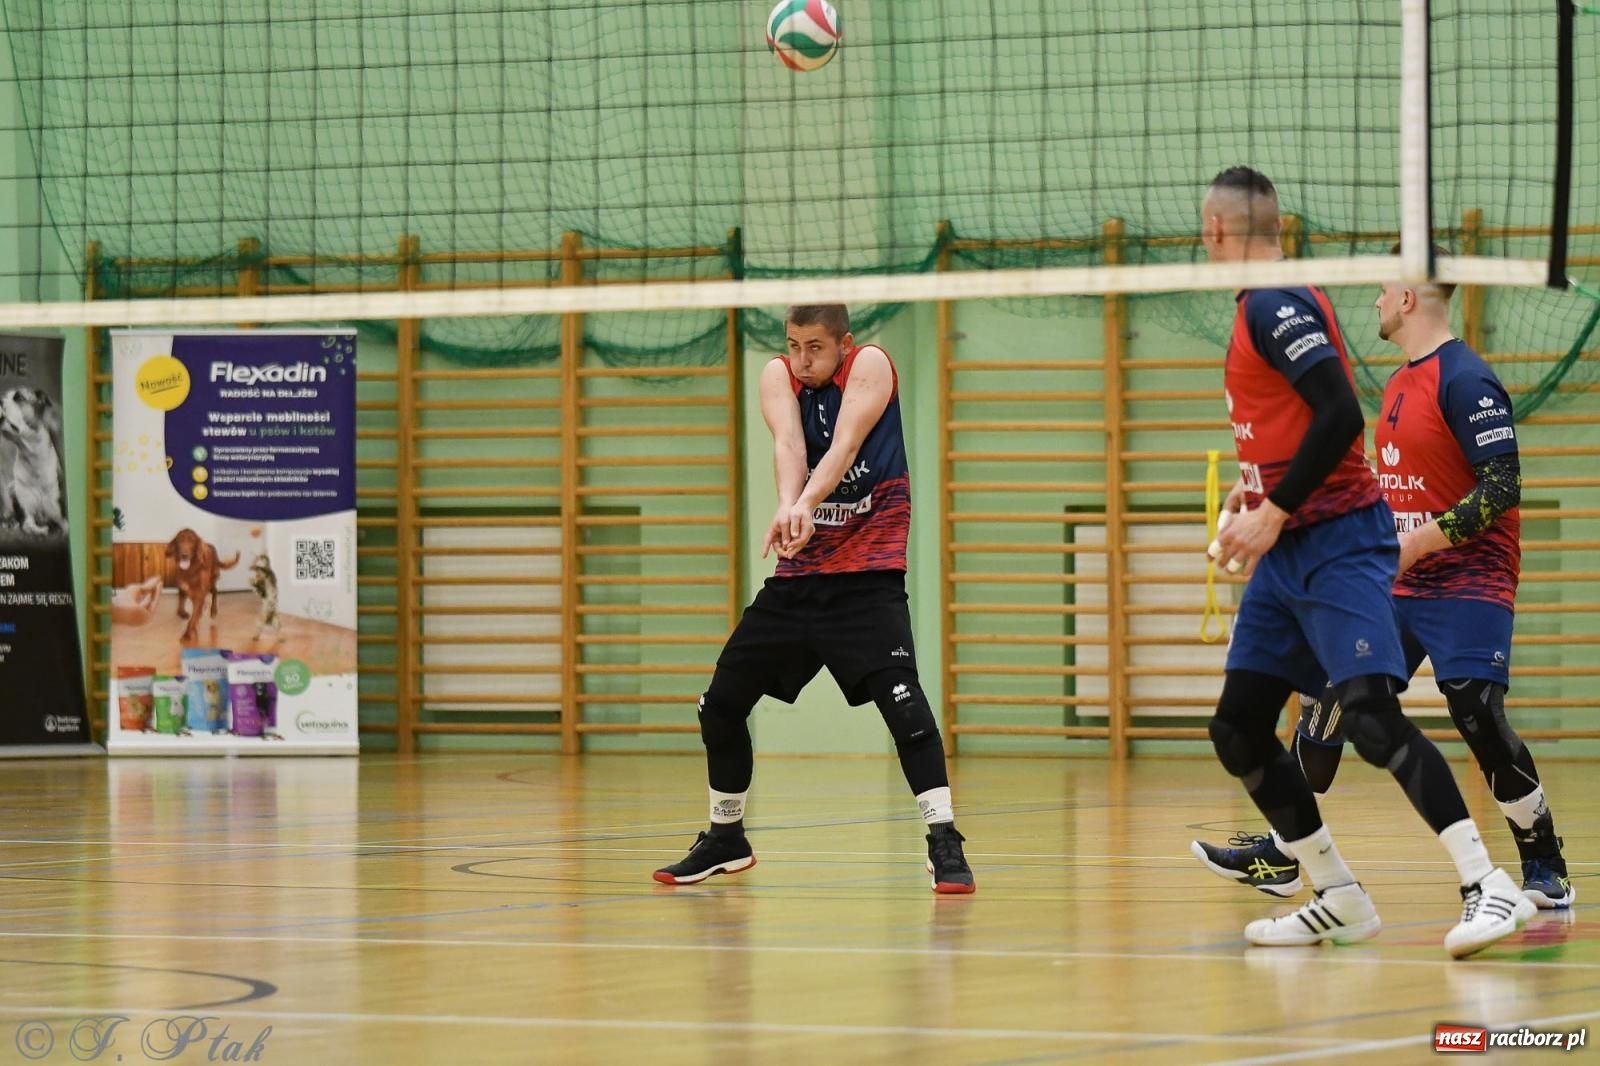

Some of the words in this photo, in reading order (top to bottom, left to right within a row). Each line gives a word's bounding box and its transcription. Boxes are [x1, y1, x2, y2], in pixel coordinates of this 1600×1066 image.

[1271, 314, 1316, 340] KATOLIK
[209, 361, 328, 386] Flexadin
[139, 373, 184, 393] Nowość
[219, 387, 261, 399] RADOŚĆ
[262, 389, 277, 399] NA
[208, 410, 264, 424] Wsparcie
[266, 410, 331, 423] mobilności
[1387, 391, 1405, 431] 4
[1468, 406, 1509, 424] KATOLIK
[202, 426, 247, 438] stawów
[249, 428, 257, 438] u
[260, 426, 290, 439] psów
[299, 425, 337, 438] kotów
[1476, 427, 1514, 446] nowiny.pl
[0, 555, 29, 570] AKOM
